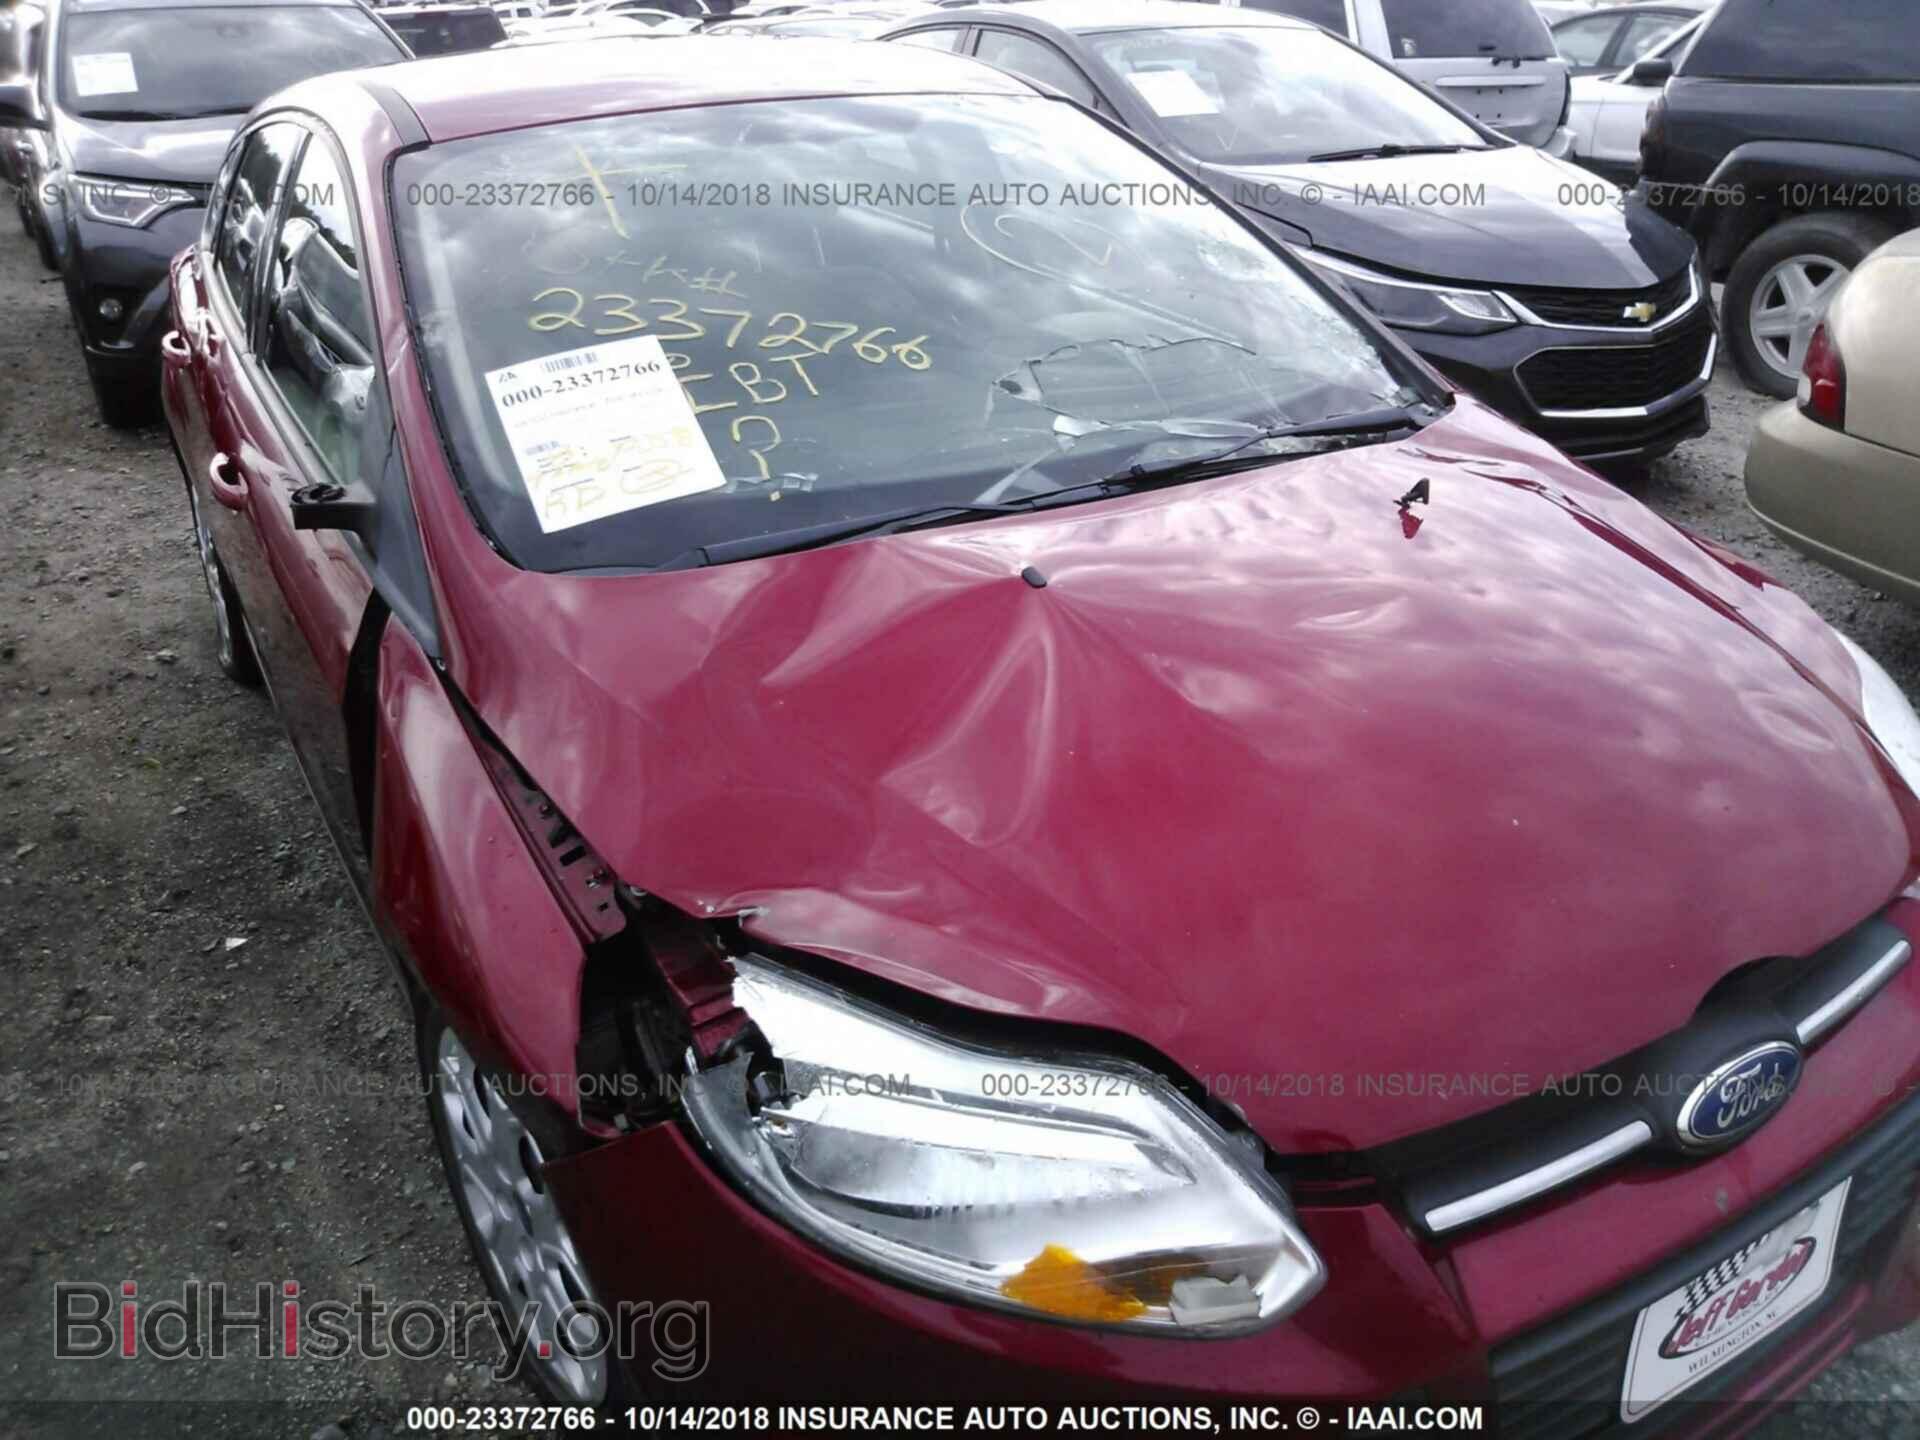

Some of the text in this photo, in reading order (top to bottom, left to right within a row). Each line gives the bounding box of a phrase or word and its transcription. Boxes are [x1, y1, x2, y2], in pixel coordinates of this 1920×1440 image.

[528, 286, 932, 371] 23372766
[500, 359, 661, 409] 000-23372766
[1717, 1062, 1785, 1128] Ford
